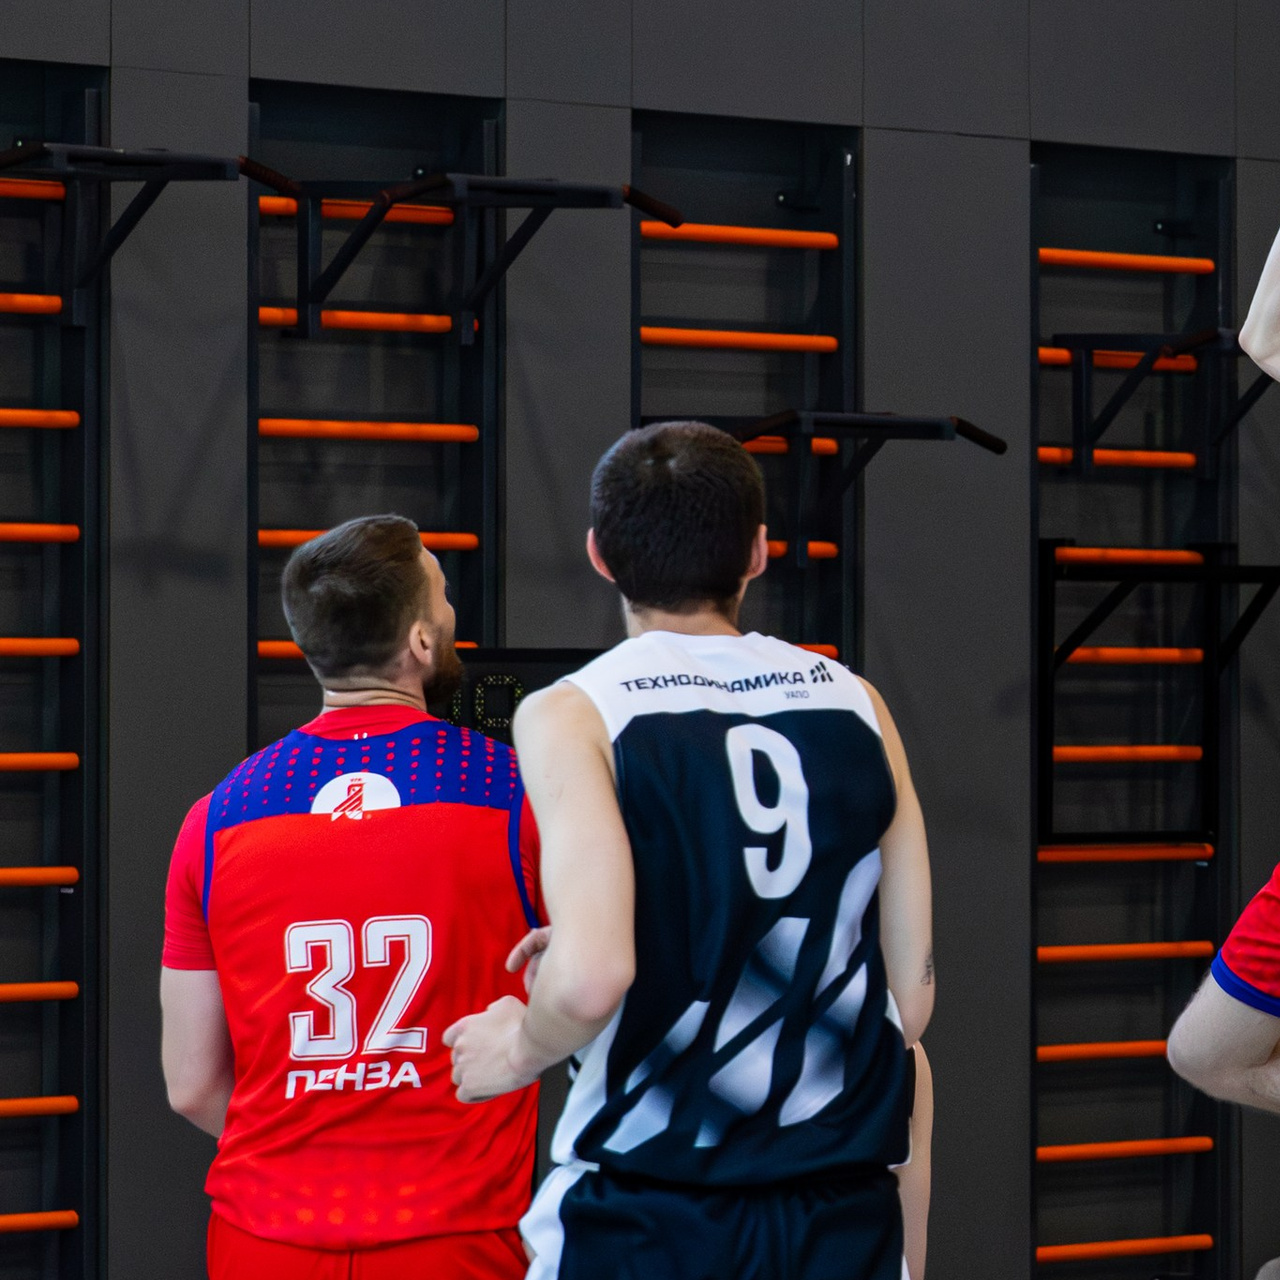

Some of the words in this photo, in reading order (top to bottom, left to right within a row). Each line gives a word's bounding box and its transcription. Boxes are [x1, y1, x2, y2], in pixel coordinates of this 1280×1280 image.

[620, 671, 805, 693] ТЕХНОДИНАМИКА
[726, 723, 813, 899] 9
[284, 914, 433, 1061] 32
[284, 1061, 422, 1100] ПЕНЗА
